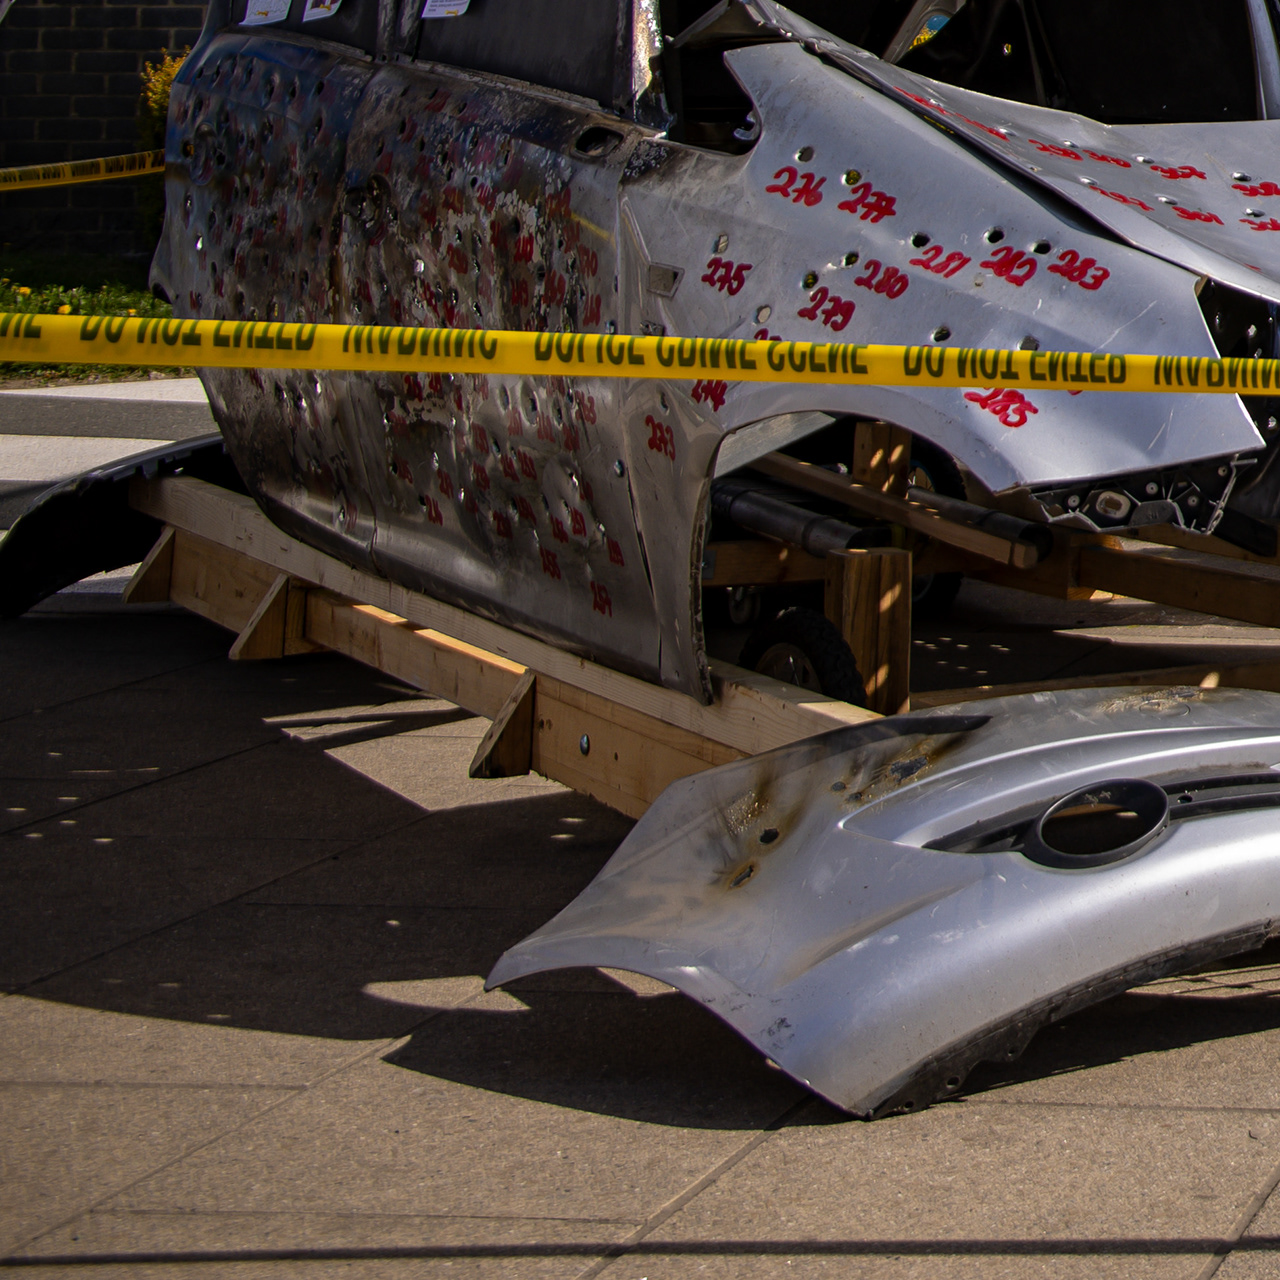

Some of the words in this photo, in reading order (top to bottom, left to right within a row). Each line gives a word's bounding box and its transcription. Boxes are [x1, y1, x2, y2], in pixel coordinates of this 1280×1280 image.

[765, 165, 827, 207] 276
[701, 257, 753, 295] 275
[854, 259, 909, 299] 280
[909, 245, 972, 278] 281
[1047, 249, 1110, 290] 283
[798, 287, 855, 332] 279
[645, 414, 676, 461] 273
